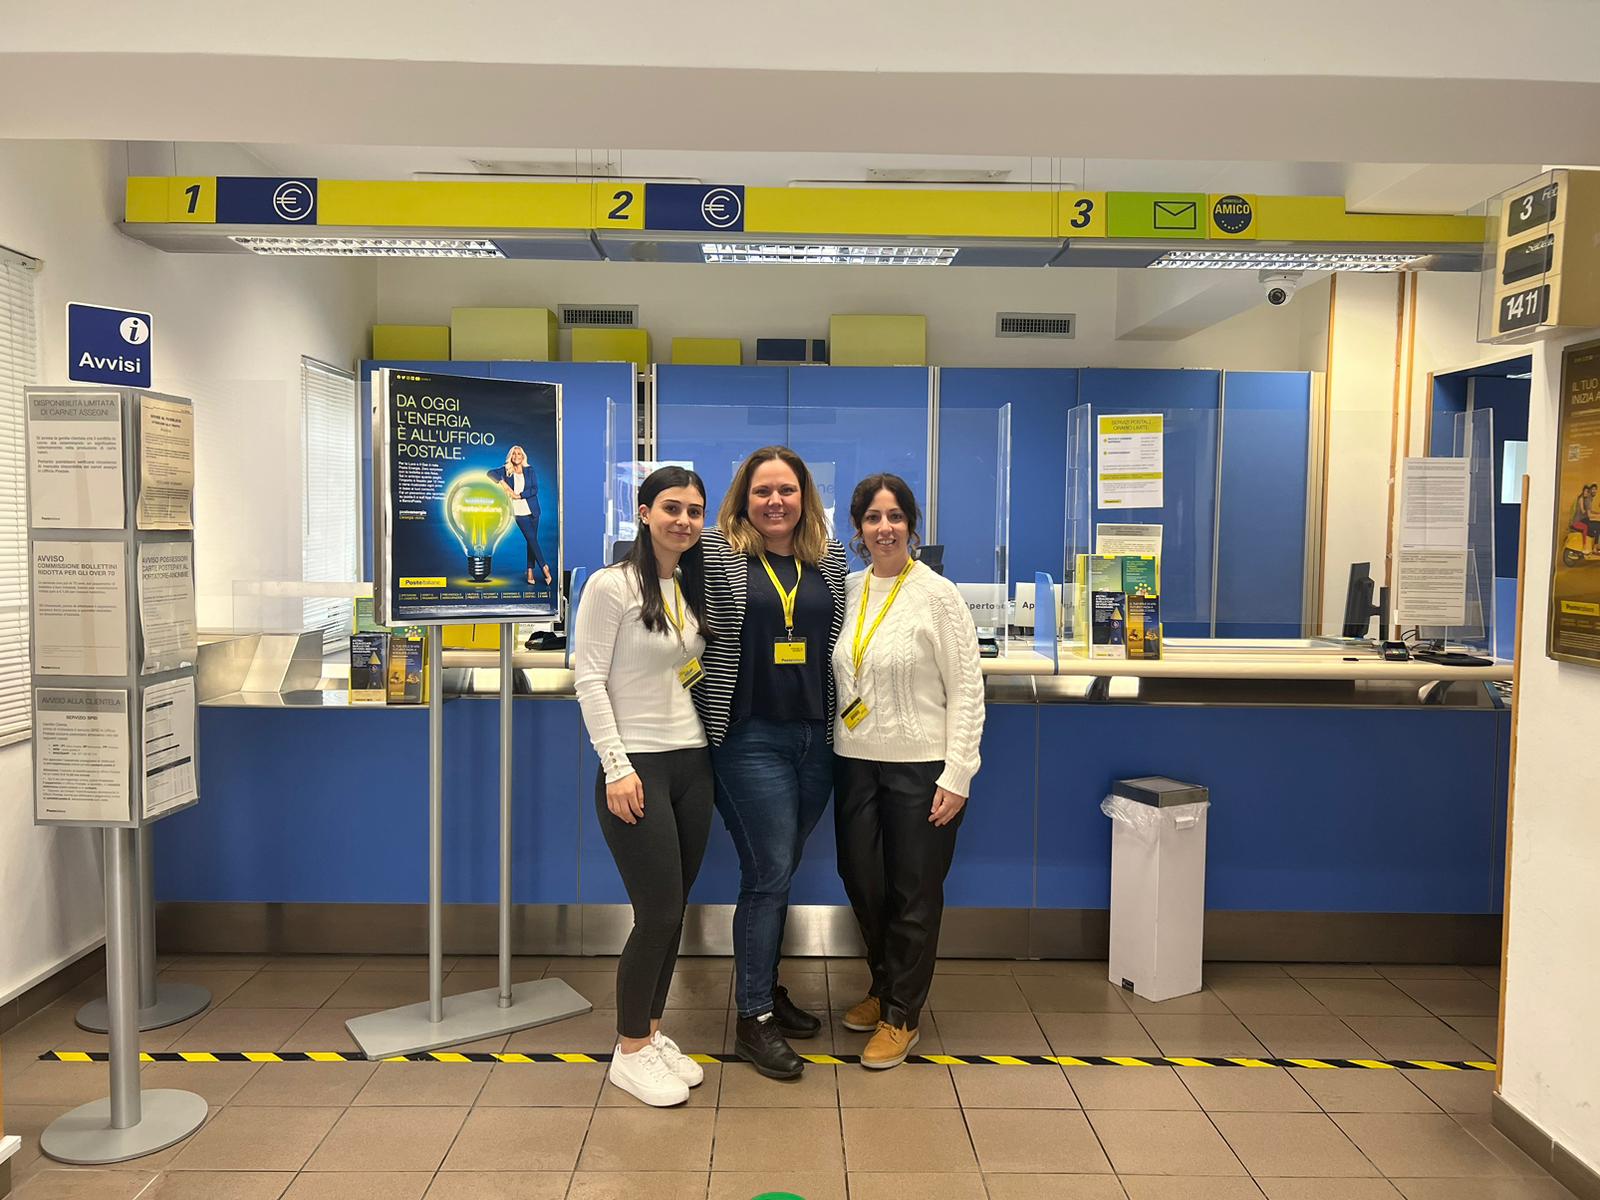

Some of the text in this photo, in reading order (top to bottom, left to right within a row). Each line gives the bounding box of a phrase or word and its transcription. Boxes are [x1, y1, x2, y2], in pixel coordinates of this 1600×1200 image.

[184, 184, 201, 214] 1
[608, 191, 634, 220] 2
[1520, 194, 1534, 220] 3
[1070, 199, 1094, 228] 3
[1215, 204, 1250, 214] AMICO
[79, 352, 141, 373] Avvisi
[396, 394, 460, 411] DA OGGI
[397, 410, 471, 428] L'ENERGIA
[410, 428, 495, 446] ALL'UFFICIO
[398, 444, 466, 460] POSTALE.
[67, 697, 84, 705] ALLA
